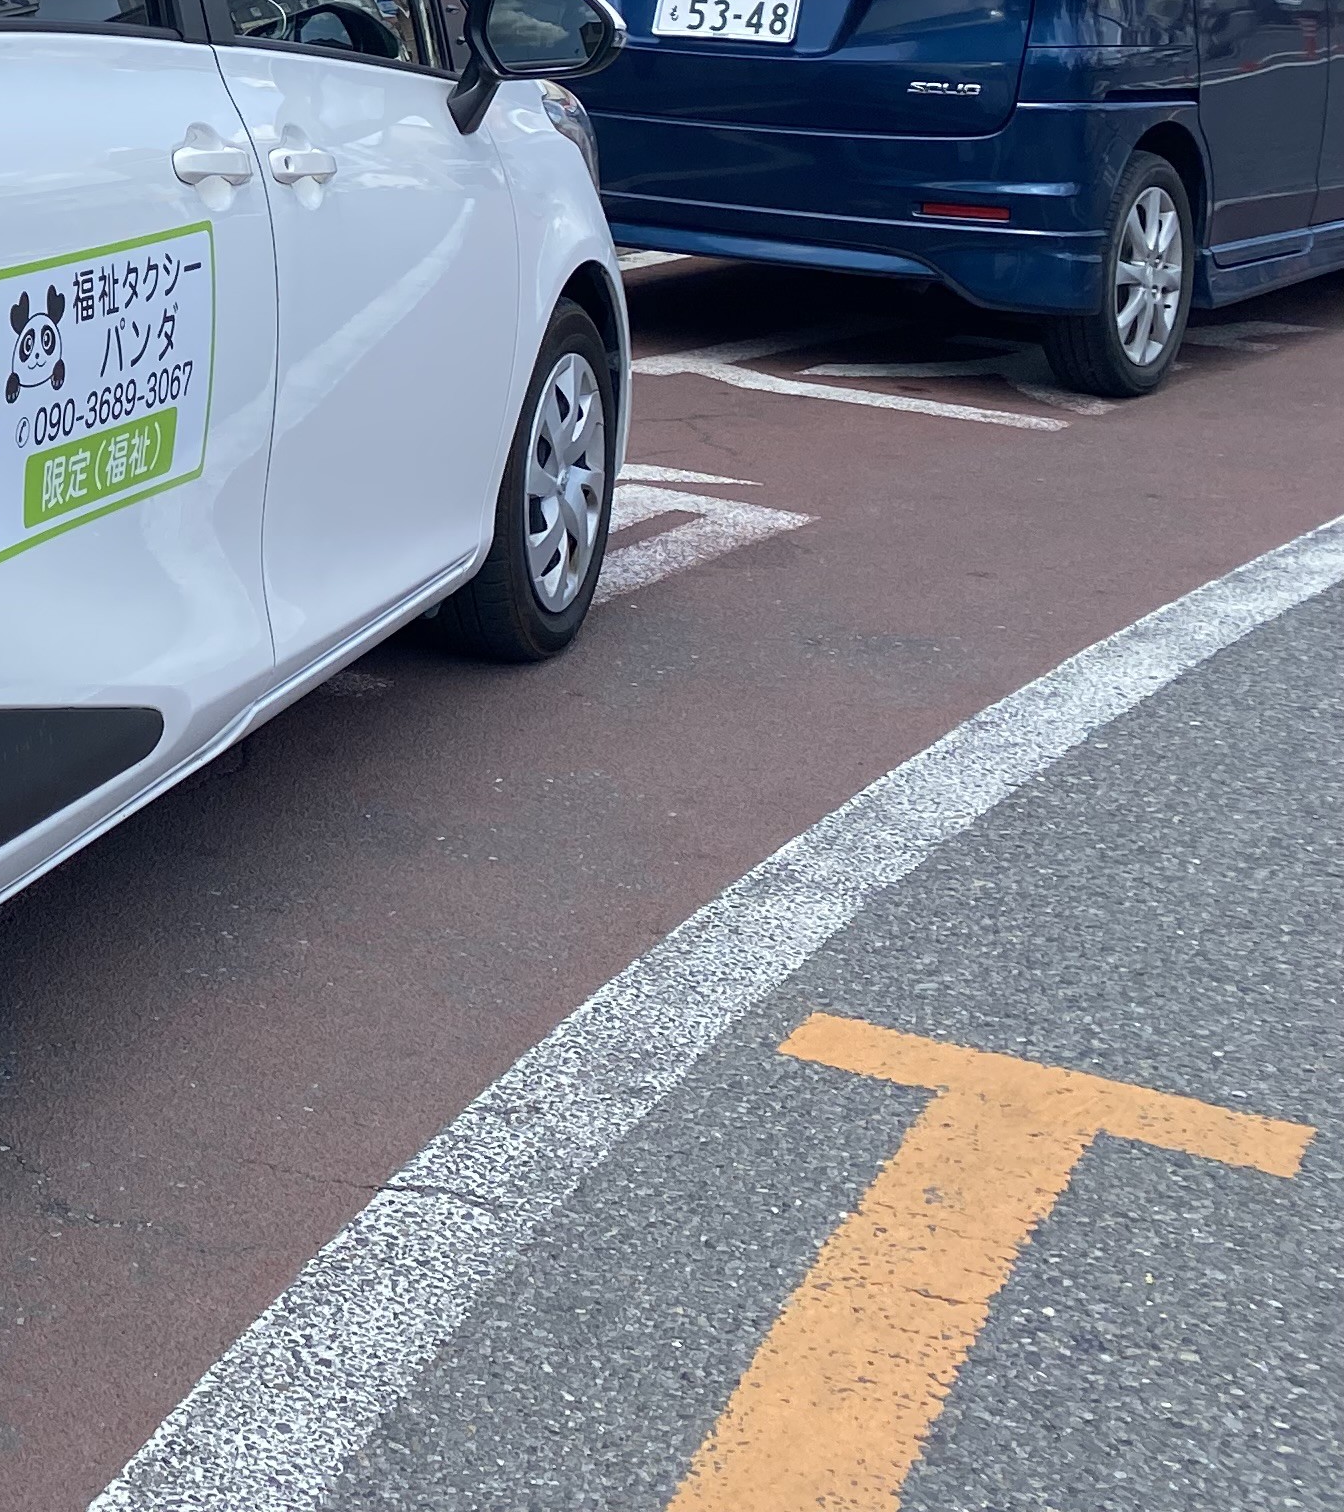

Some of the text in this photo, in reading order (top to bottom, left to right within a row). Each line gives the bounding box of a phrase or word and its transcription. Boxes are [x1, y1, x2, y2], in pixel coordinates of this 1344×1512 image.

[71, 252, 202, 324] 福祉タクシー
[100, 302, 180, 378] パンダ
[33, 360, 194, 446] 090-3689-3067
[41, 421, 162, 512] 限定（福祉）
